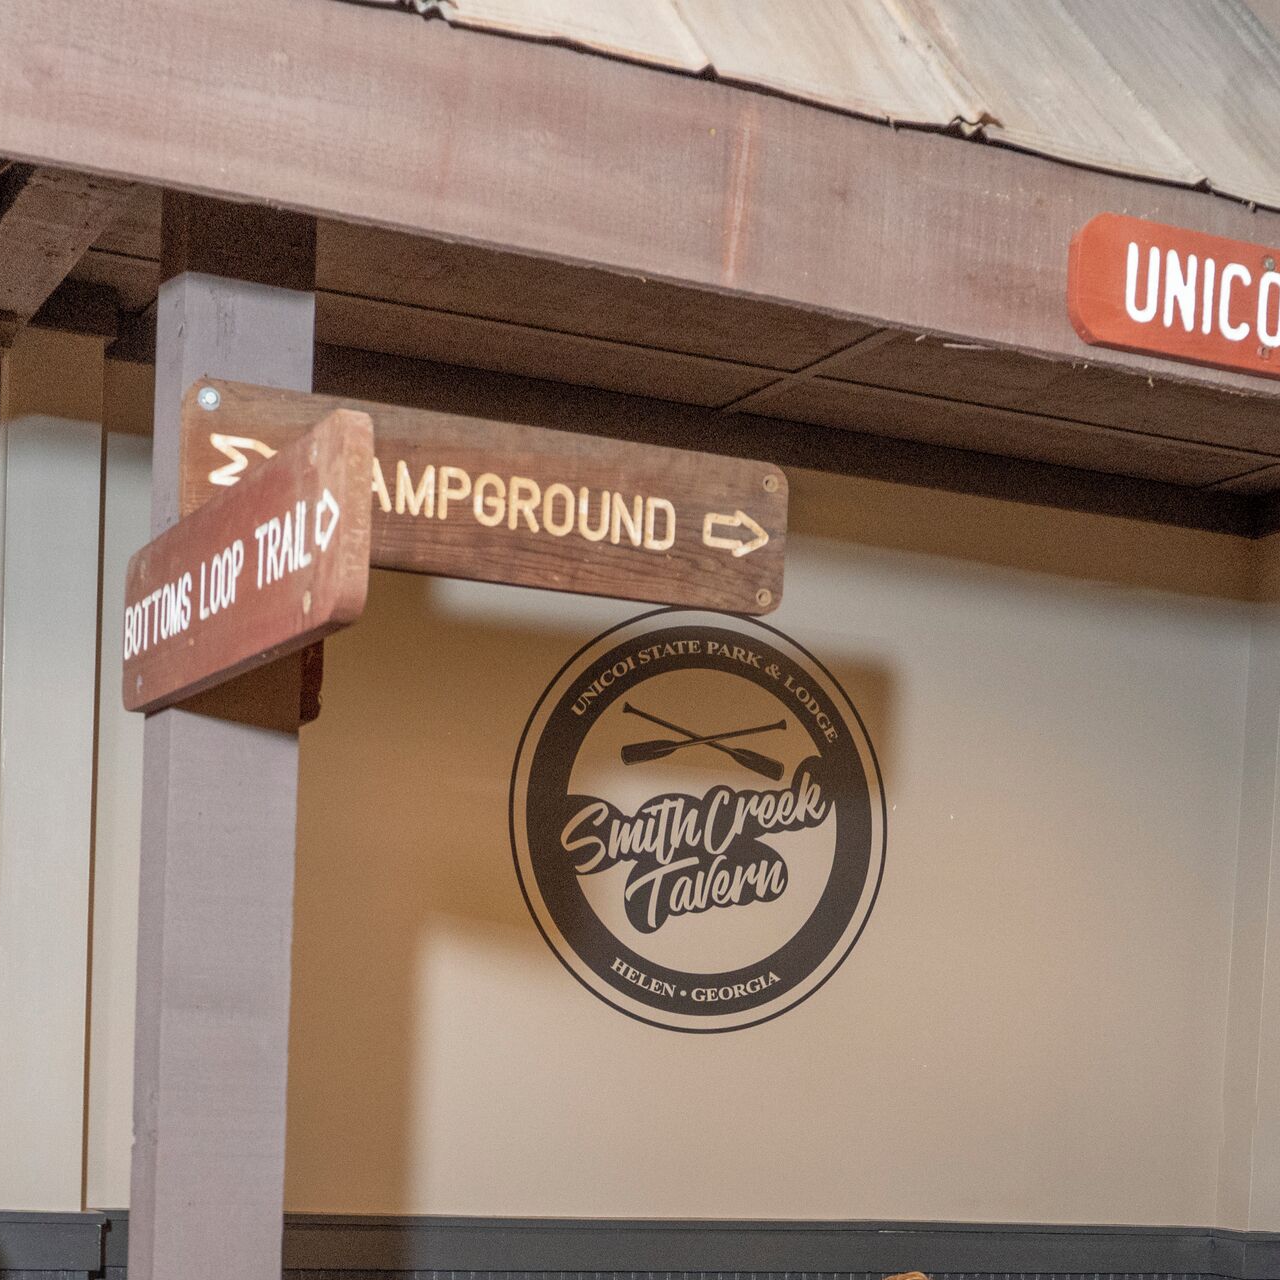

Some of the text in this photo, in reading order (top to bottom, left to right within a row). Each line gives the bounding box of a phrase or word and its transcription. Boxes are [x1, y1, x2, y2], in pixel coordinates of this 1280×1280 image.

[371, 457, 676, 552] AMPGROUND
[124, 500, 312, 660] BOTTOMS LOOP TRAIL
[571, 640, 839, 744] UNICOI STATE PARK & LODGE
[560, 771, 827, 874] Smith Creek
[625, 854, 786, 929] Tavern
[610, 956, 782, 1002] HELEN GEORGIA
